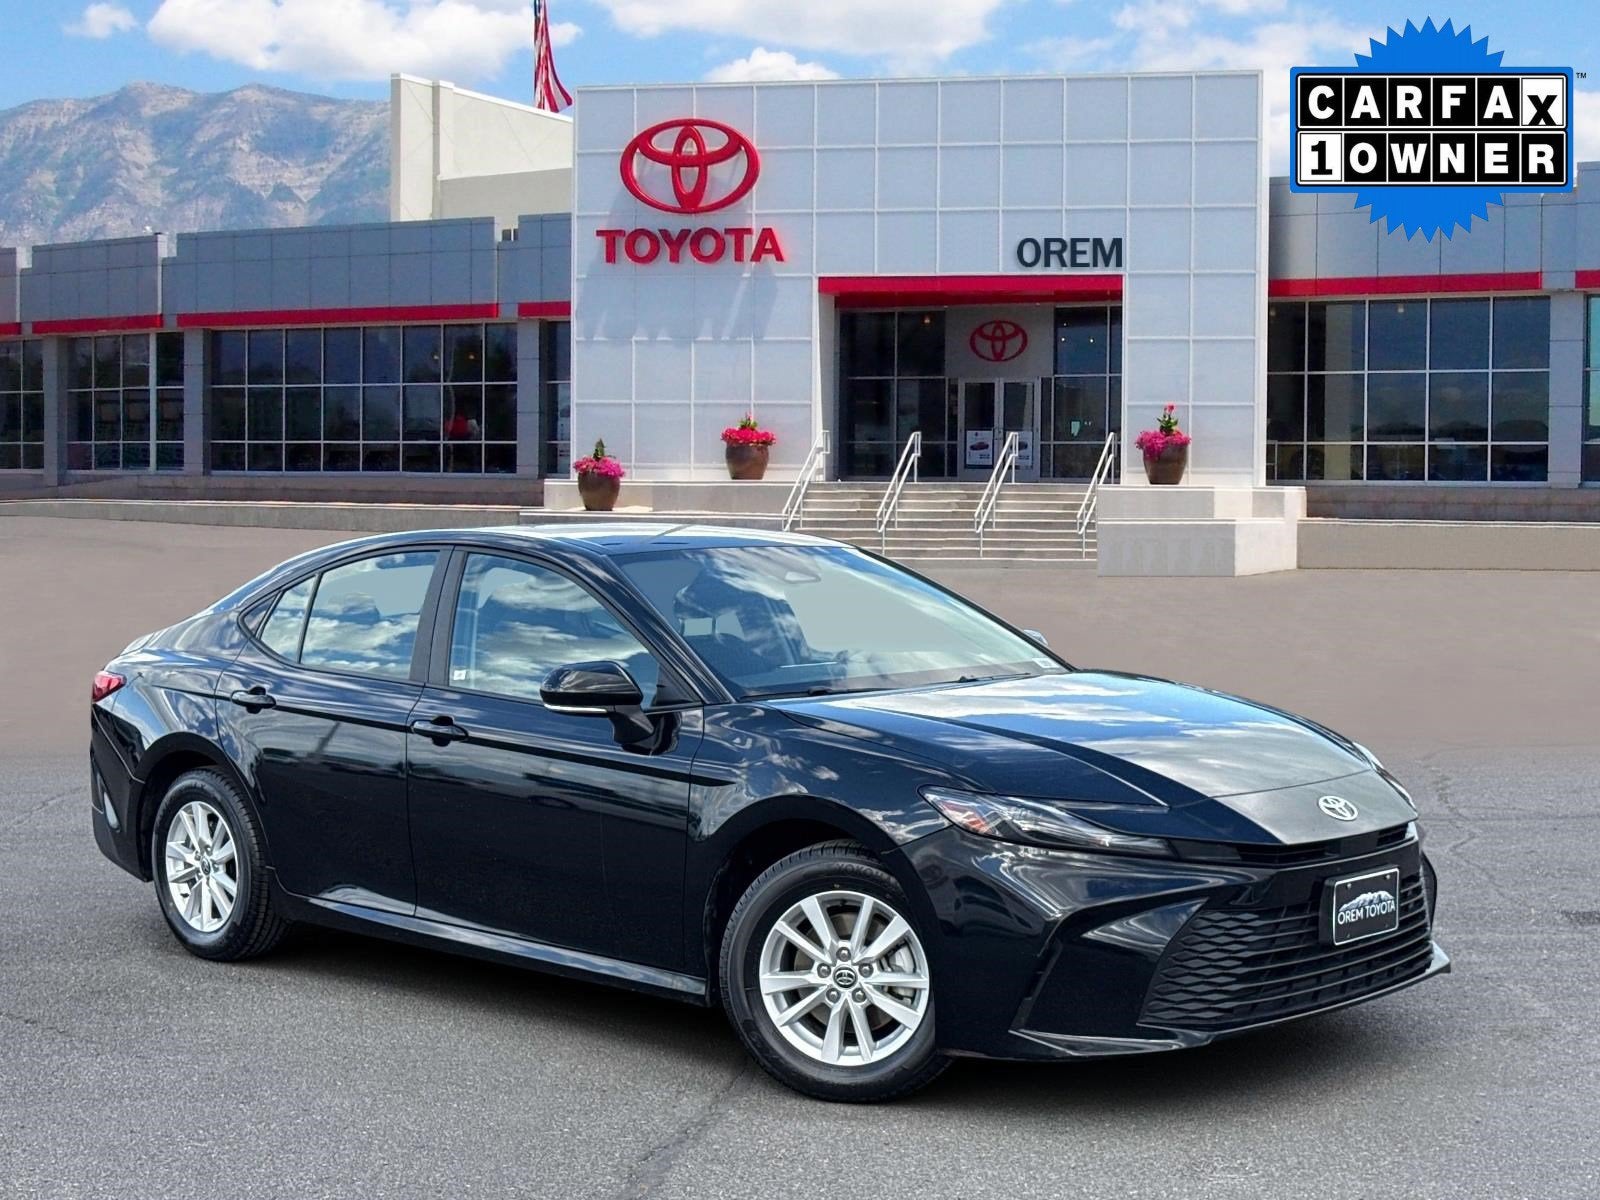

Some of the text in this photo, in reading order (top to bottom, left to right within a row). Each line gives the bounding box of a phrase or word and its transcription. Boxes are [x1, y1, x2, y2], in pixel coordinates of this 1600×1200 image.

[596, 227, 784, 264] TOYOTA
[1017, 238, 1123, 268] OREM
[1337, 900, 1395, 925] OREM TOYOTA
